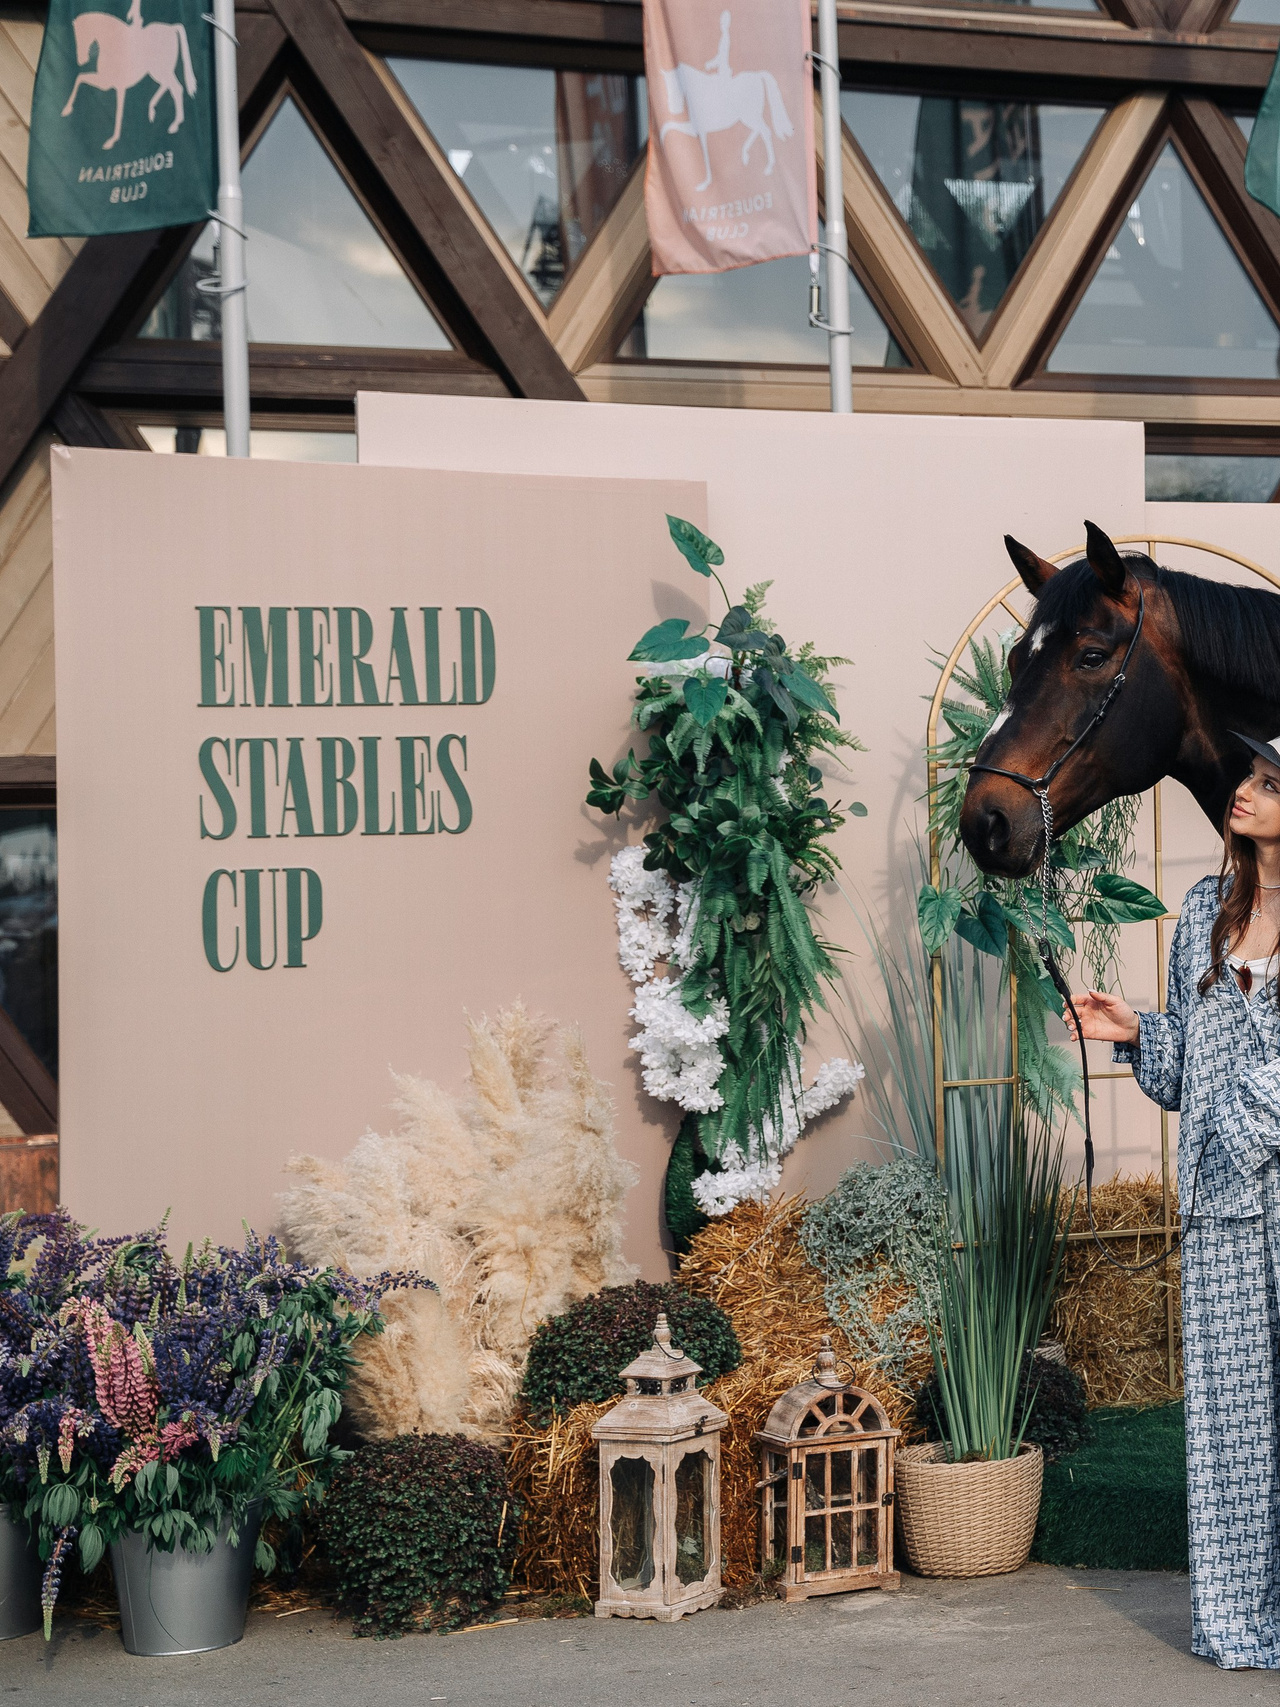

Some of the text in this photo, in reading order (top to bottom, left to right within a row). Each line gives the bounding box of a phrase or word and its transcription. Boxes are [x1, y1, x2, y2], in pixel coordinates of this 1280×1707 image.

[195, 606, 497, 708] EMERALD
[198, 733, 473, 840] STABLES
[201, 867, 324, 973] CUP
